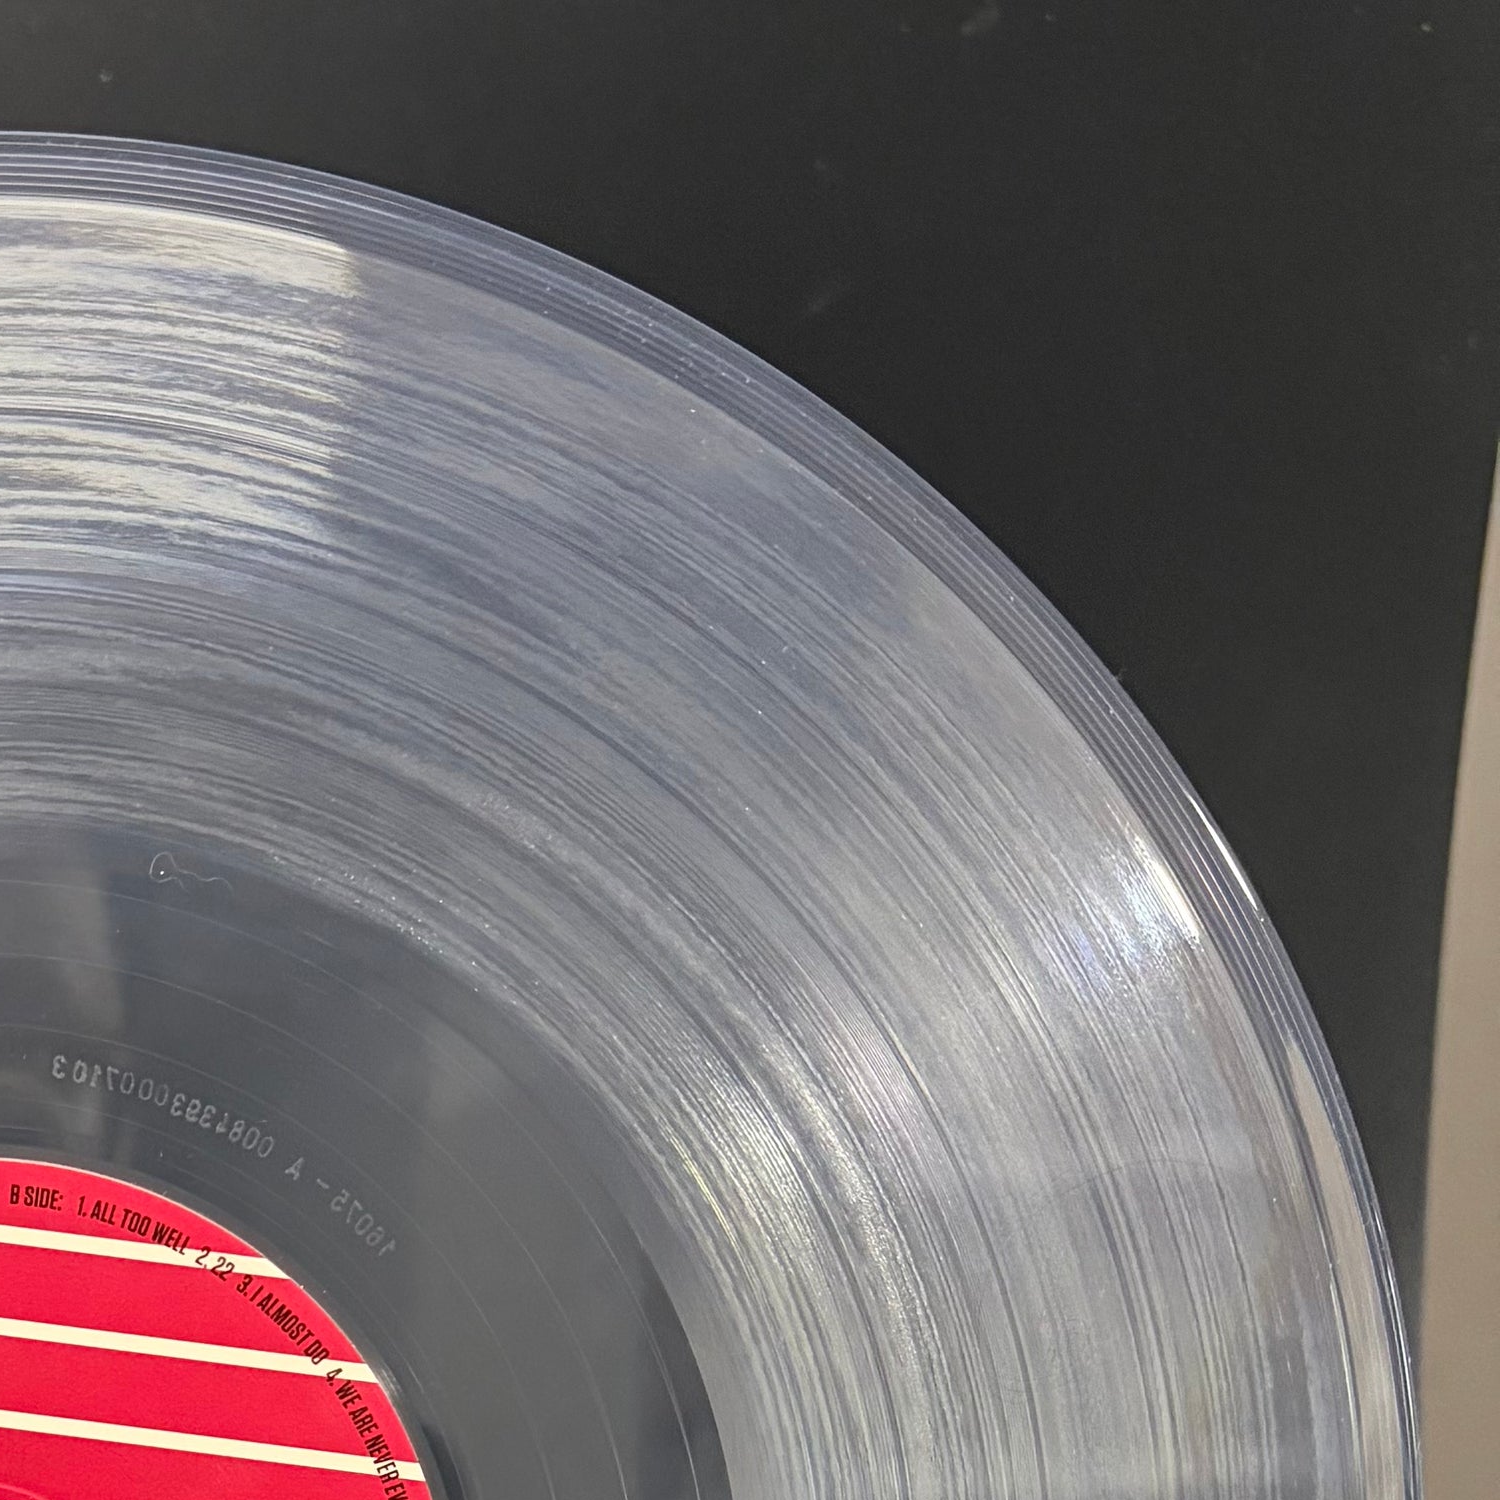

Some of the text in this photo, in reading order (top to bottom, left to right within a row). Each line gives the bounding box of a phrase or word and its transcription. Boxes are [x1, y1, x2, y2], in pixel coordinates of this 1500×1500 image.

[8, 1183, 21, 1205] B
[22, 1184, 63, 1211] SIDE:
[76, 1195, 86, 1217] 1.
[89, 1199, 116, 1225] ALL
[119, 1207, 152, 1237] TOO
[150, 1221, 190, 1256] WELL
[209, 1255, 235, 1281] 22
[235, 1272, 253, 1296] 3.
[249, 1285, 264, 1302] I
[255, 1292, 314, 1346] ALMOST
[302, 1338, 330, 1365] DO
[325, 1367, 343, 1386] 4.
[334, 1378, 362, 1409] WE
[347, 1405, 378, 1437] ARE
[363, 1433, 400, 1484] NEVER
